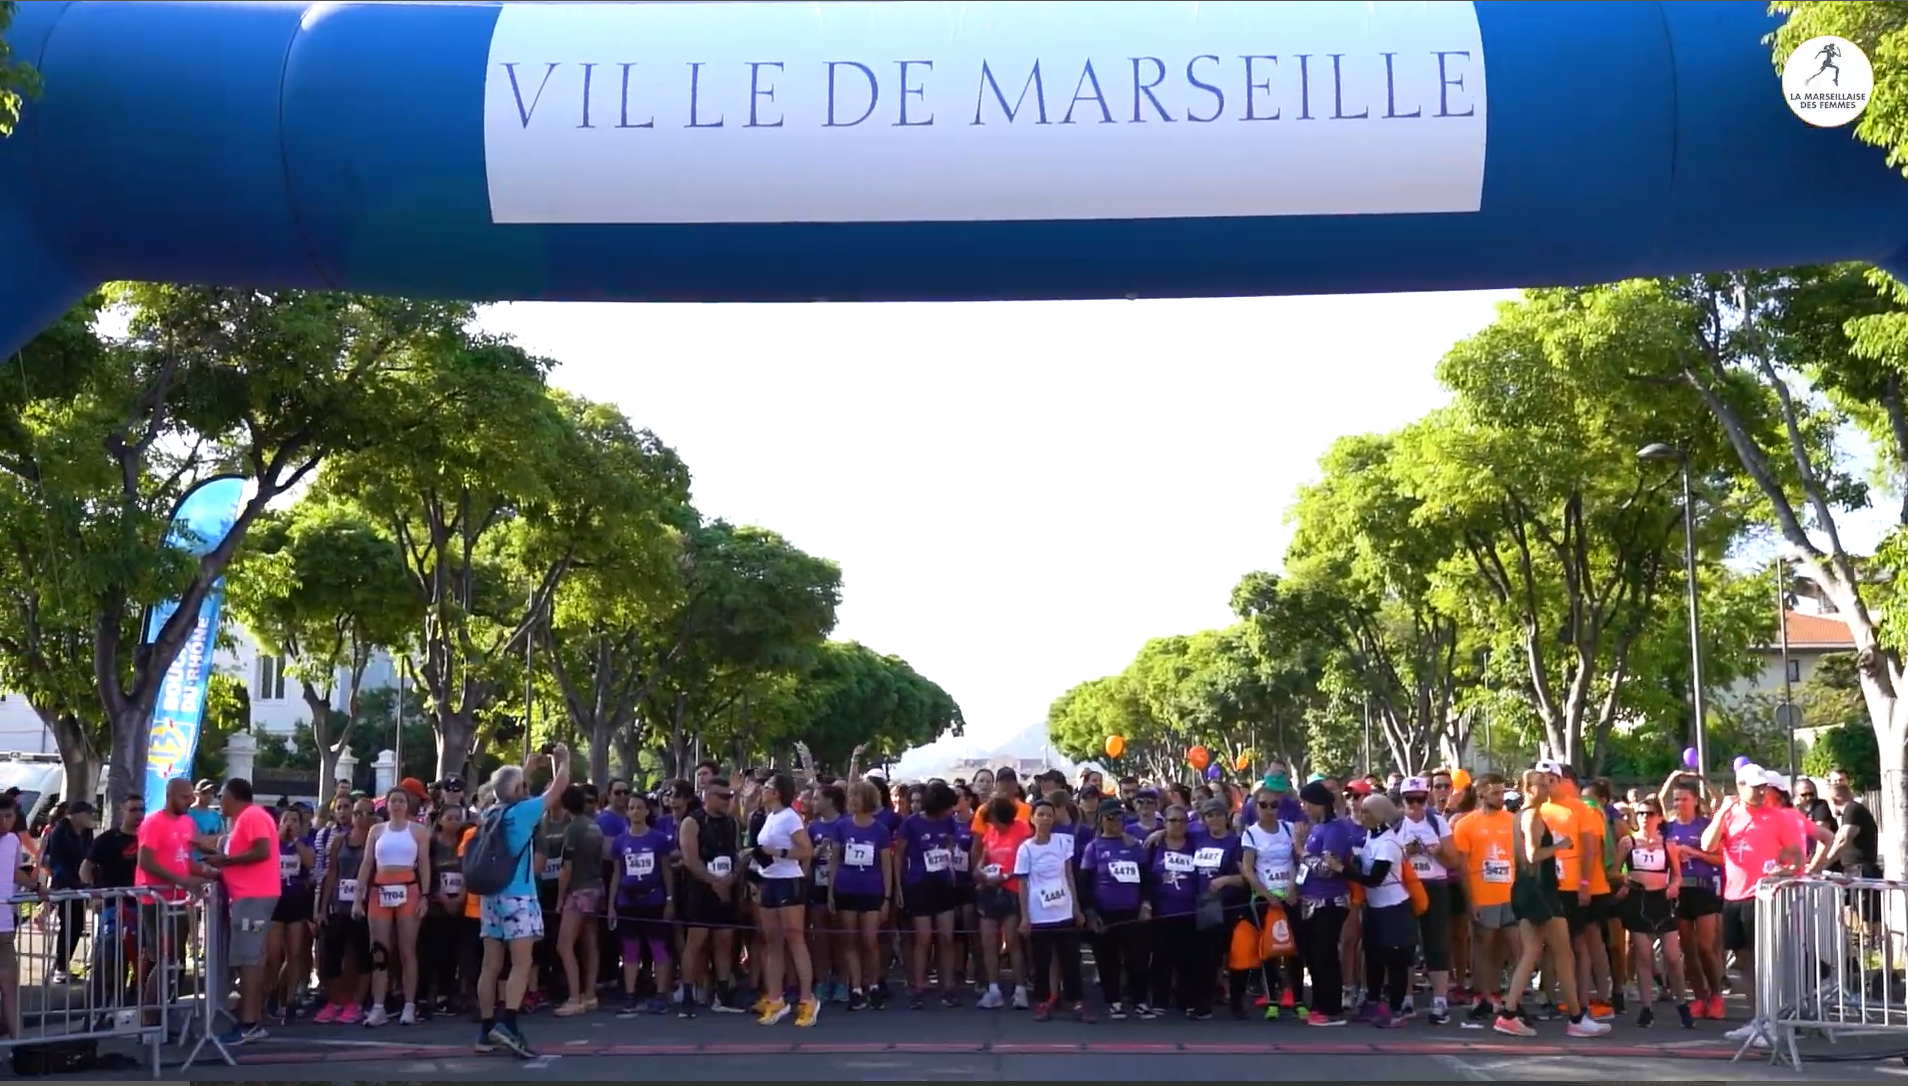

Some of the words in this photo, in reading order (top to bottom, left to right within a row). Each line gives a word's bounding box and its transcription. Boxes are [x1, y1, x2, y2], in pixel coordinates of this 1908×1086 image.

[500, 61, 785, 129] VILLE
[821, 60, 934, 127] DE
[969, 51, 1475, 126] MARSEILLE
[162, 647, 187, 711] BOUC
[854, 849, 865, 859] 77
[1641, 854, 1655, 863] 71
